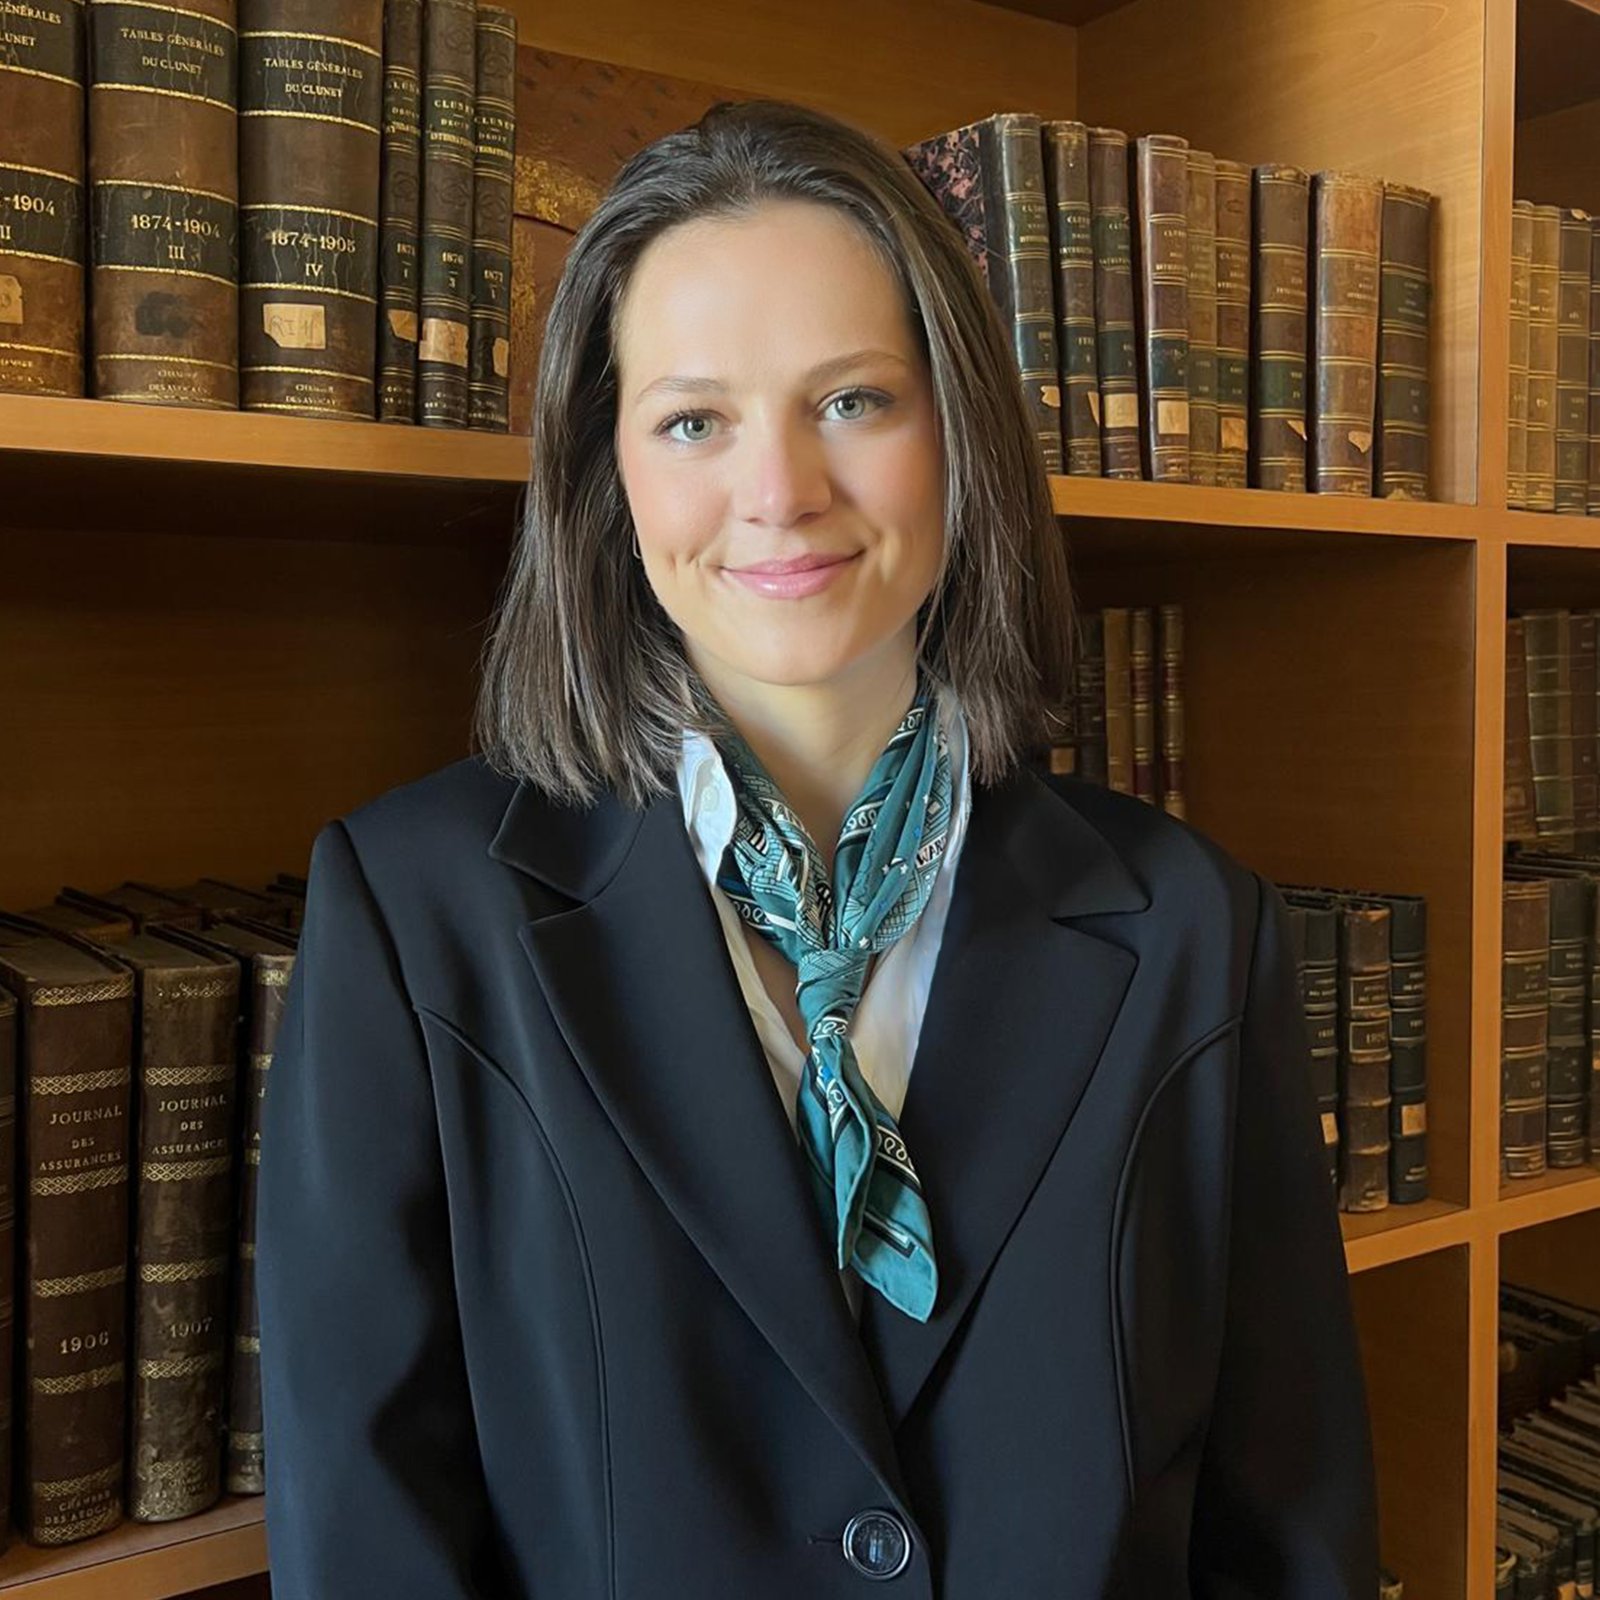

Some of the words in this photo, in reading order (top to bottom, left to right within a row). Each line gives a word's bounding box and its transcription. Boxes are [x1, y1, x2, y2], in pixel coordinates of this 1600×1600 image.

[121, 28, 164, 42] TABLES
[142, 56, 158, 67] DU
[160, 60, 202, 74] CLUNET
[263, 58, 304, 70] TABLES
[285, 84, 300, 93] DU
[302, 84, 342, 97] CLUNET
[131, 214, 220, 238] 1874-1904
[271, 232, 356, 253] 1874-1905
[168, 245, 185, 260] III
[305, 263, 324, 277] IV
[158, 1094, 227, 1112] JOURNAL
[49, 1105, 122, 1125] JOURNAL
[180, 1120, 204, 1131] DES
[71, 1137, 95, 1150] DES
[39, 1152, 121, 1171] ASSURANCES
[170, 1316, 213, 1339] 1907
[60, 1331, 109, 1354] 1906
